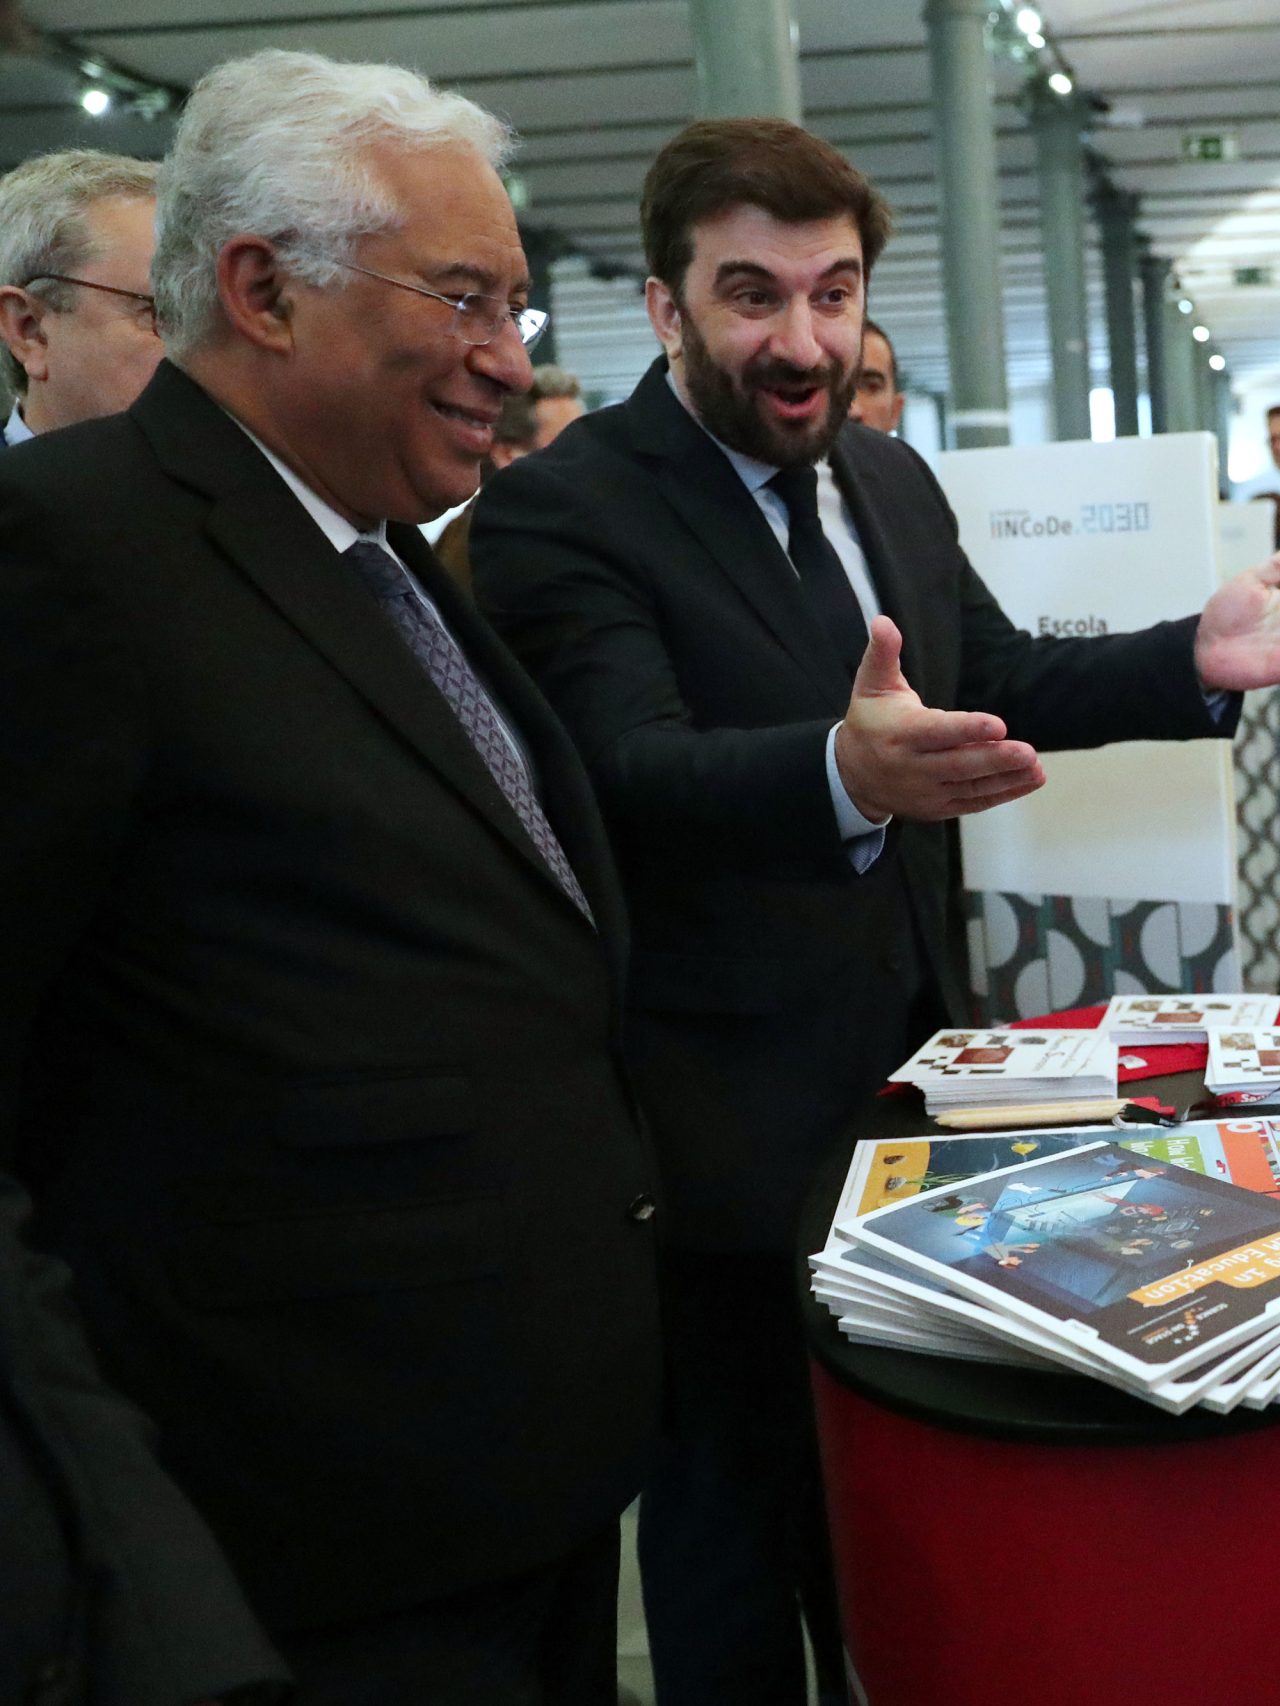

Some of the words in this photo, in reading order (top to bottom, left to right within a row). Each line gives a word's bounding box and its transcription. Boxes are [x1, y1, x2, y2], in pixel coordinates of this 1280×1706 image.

[1038, 614, 1108, 636] Escola
[1167, 1138, 1192, 1156] How
[1144, 1248, 1266, 1300] Education
[1233, 1267, 1268, 1283] in
